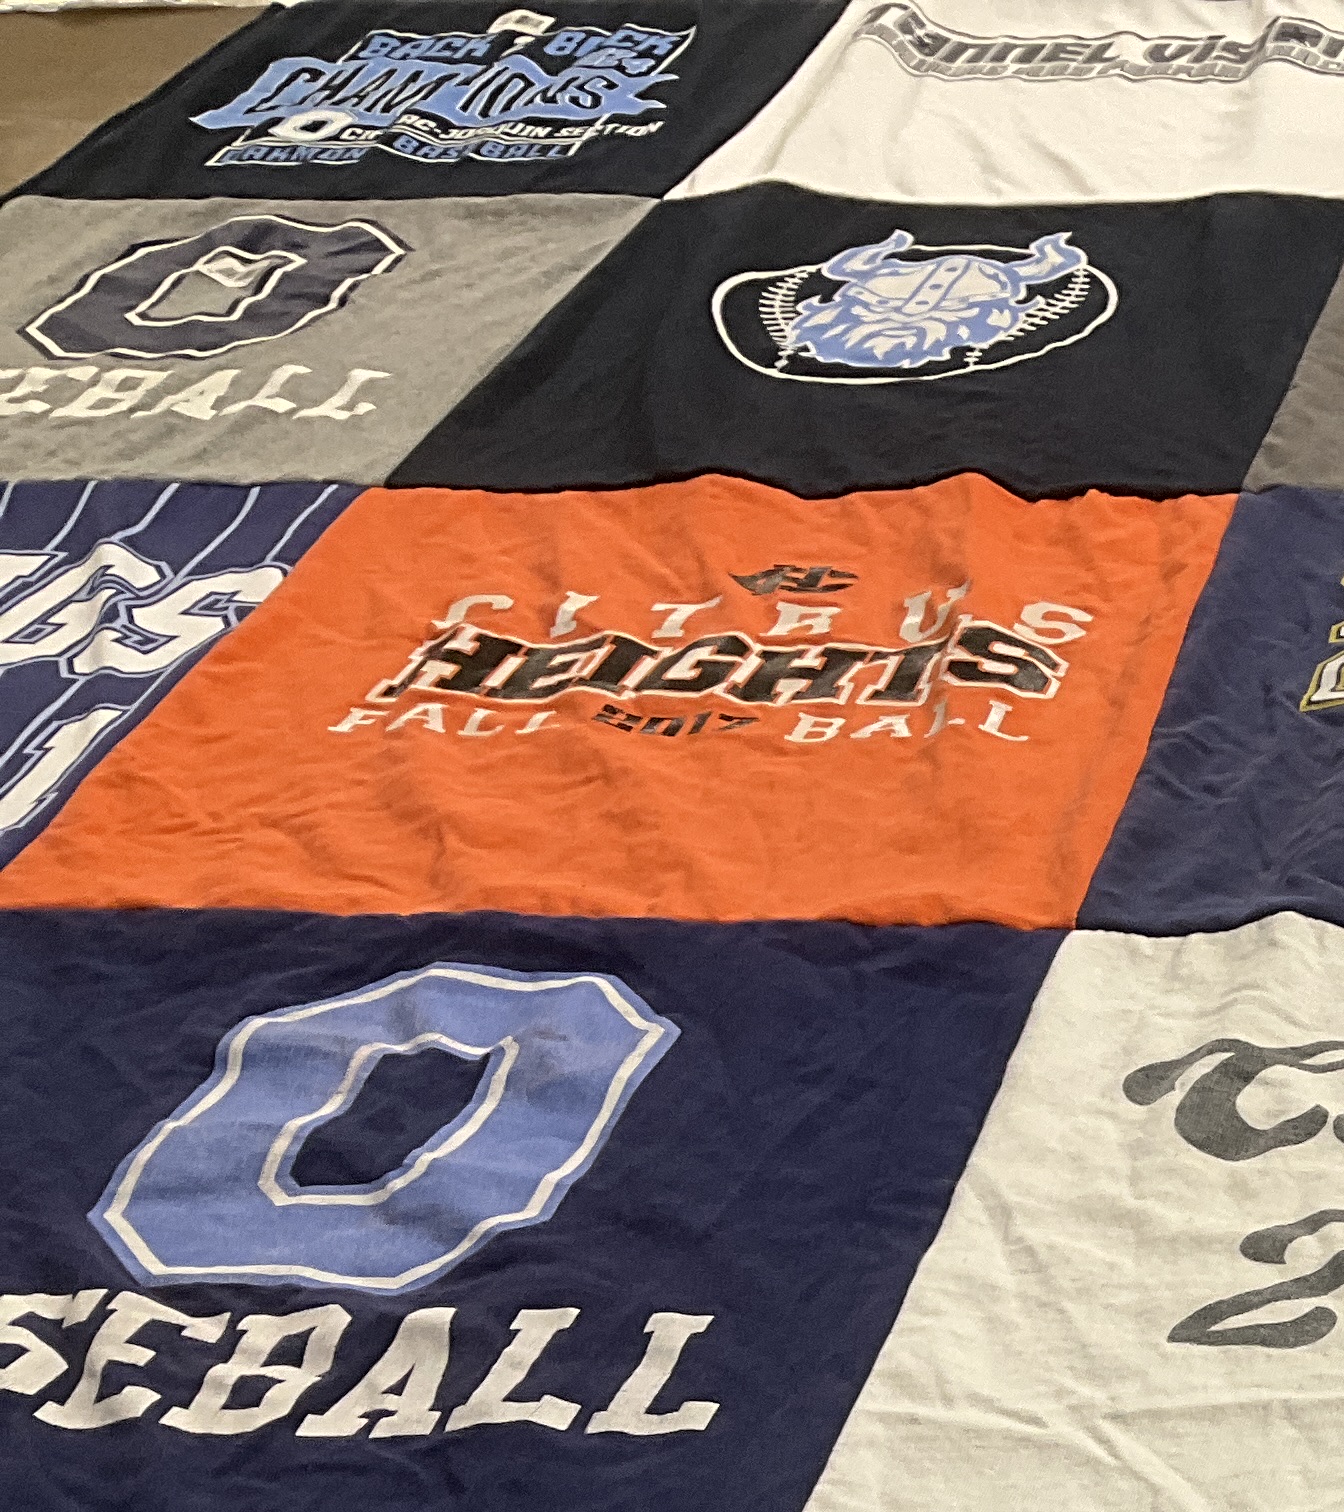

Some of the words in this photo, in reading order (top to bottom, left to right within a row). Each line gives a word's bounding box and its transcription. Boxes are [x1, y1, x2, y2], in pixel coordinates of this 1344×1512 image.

[358, 33, 496, 60] BACK
[431, 578, 1094, 645] CITRUS
[366, 618, 1069, 705] HEIGHTS
[328, 704, 562, 738] FALL
[591, 703, 758, 738] 2017
[784, 701, 1031, 742] BALL
[88, 962, 681, 1295] O
